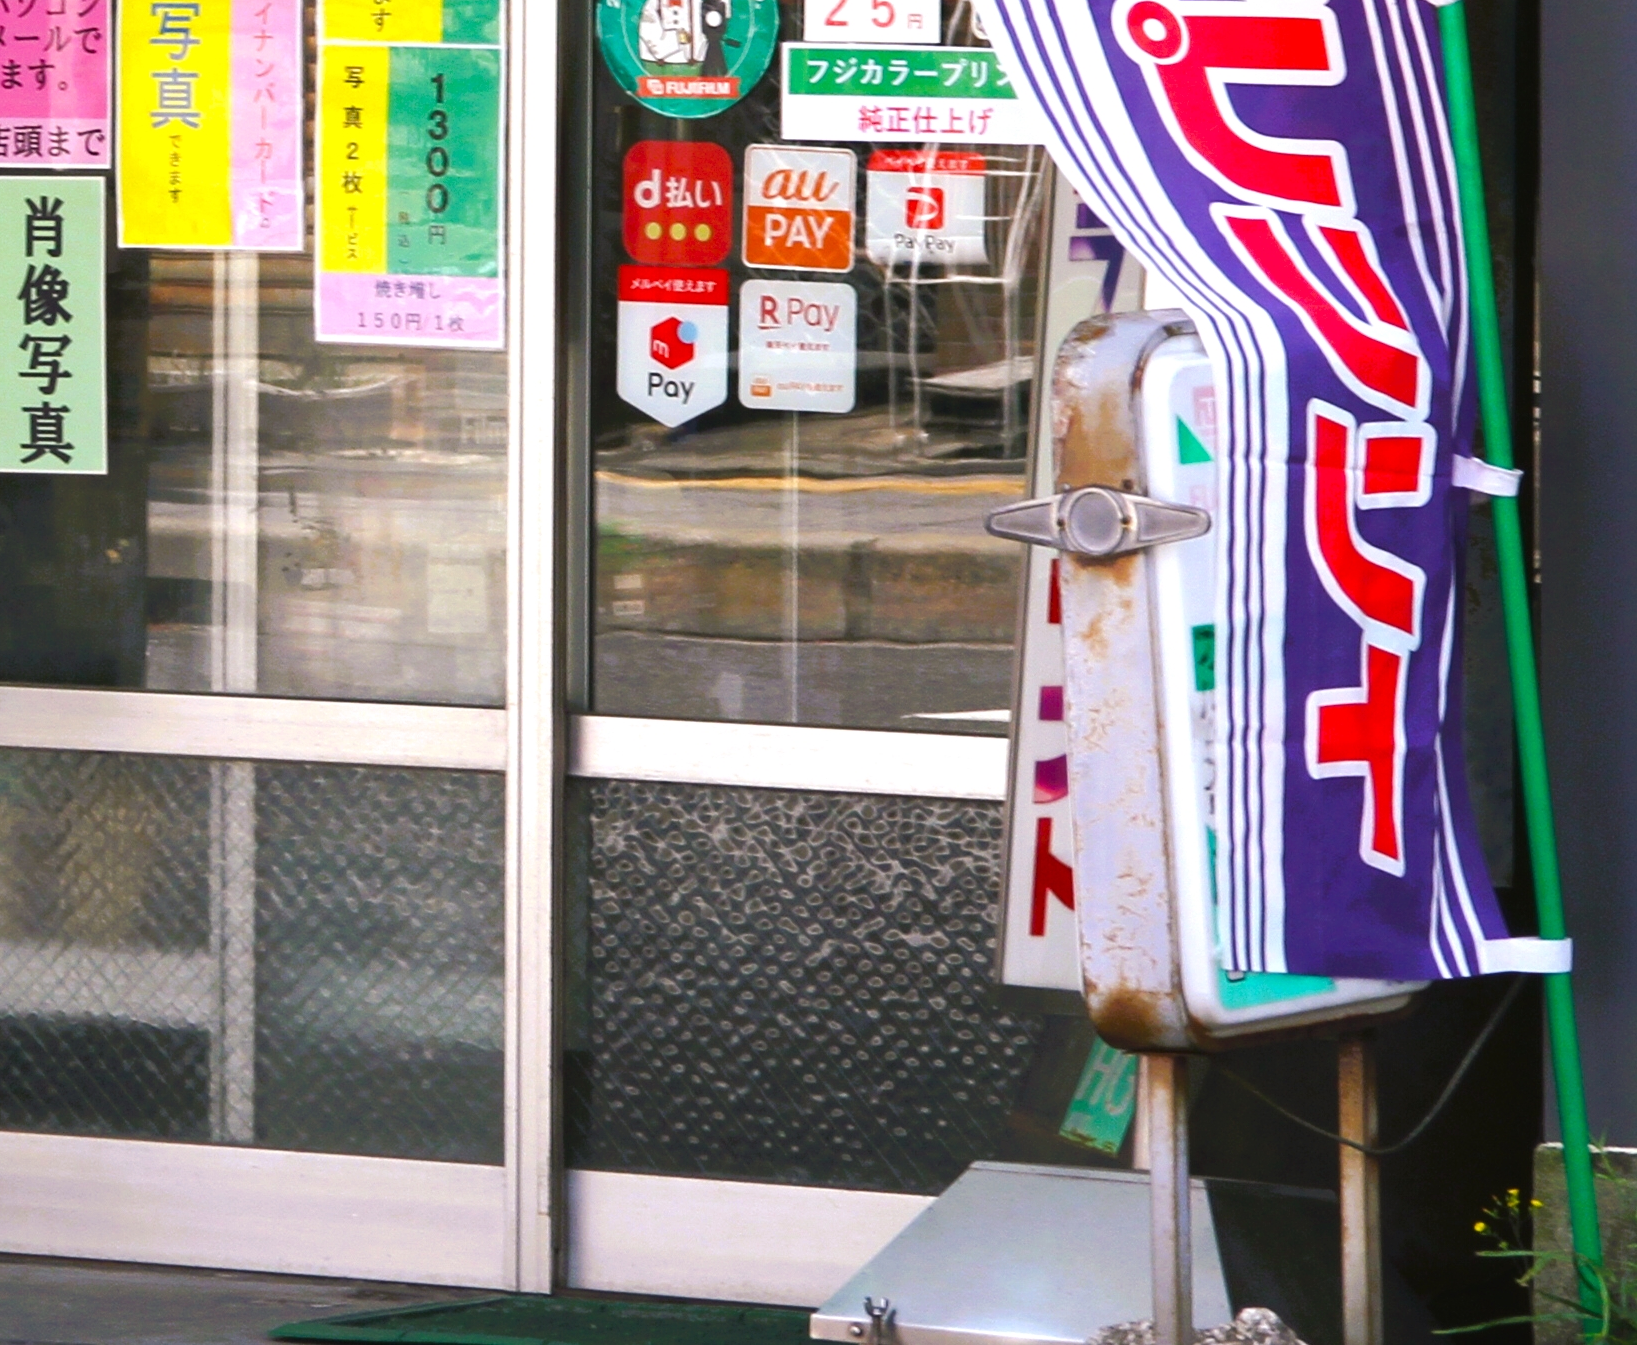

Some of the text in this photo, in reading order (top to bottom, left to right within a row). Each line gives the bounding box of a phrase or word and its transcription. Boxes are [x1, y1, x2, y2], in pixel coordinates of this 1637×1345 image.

[857, 106, 993, 135] 純正仕上げ
[633, 168, 723, 210] d払い
[761, 167, 840, 204] au
[764, 214, 835, 250] PAY
[16, 194, 75, 466] 肖像写真
[786, 296, 840, 332] Pay
[647, 372, 696, 405] Pay
